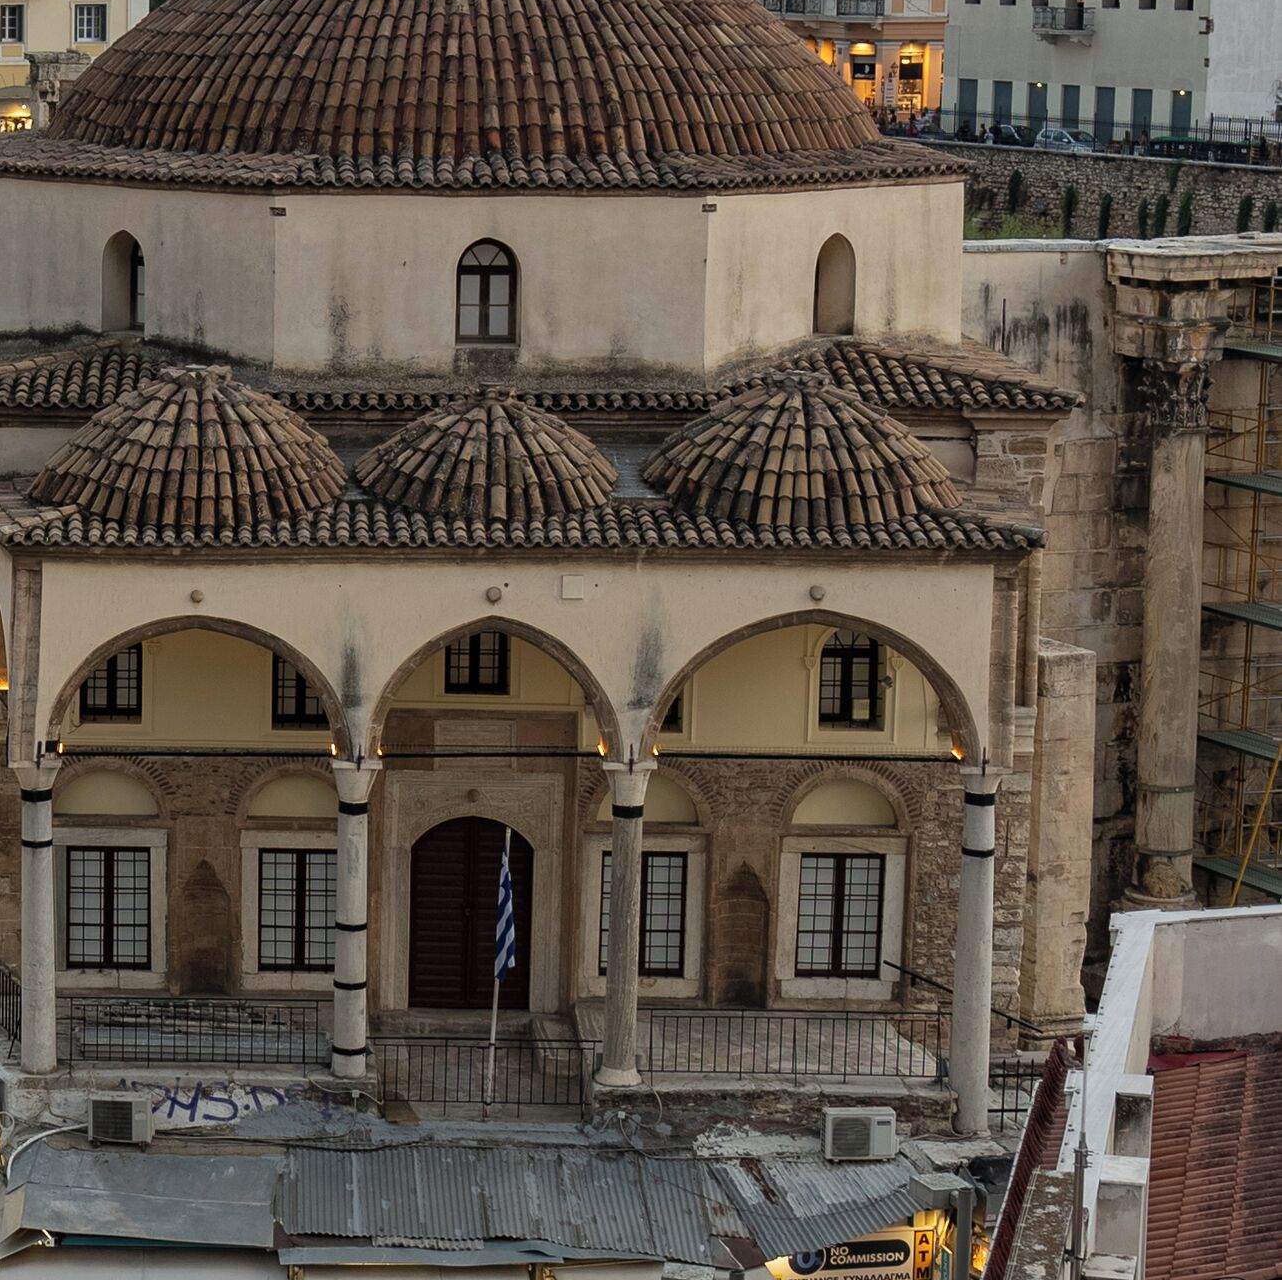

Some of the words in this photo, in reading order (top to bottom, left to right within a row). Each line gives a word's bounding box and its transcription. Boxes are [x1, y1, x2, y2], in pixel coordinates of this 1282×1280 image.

[830, 1246, 850, 1256] NO
[830, 1251, 905, 1266] COMMISSION
[917, 1233, 930, 1279] ATM
